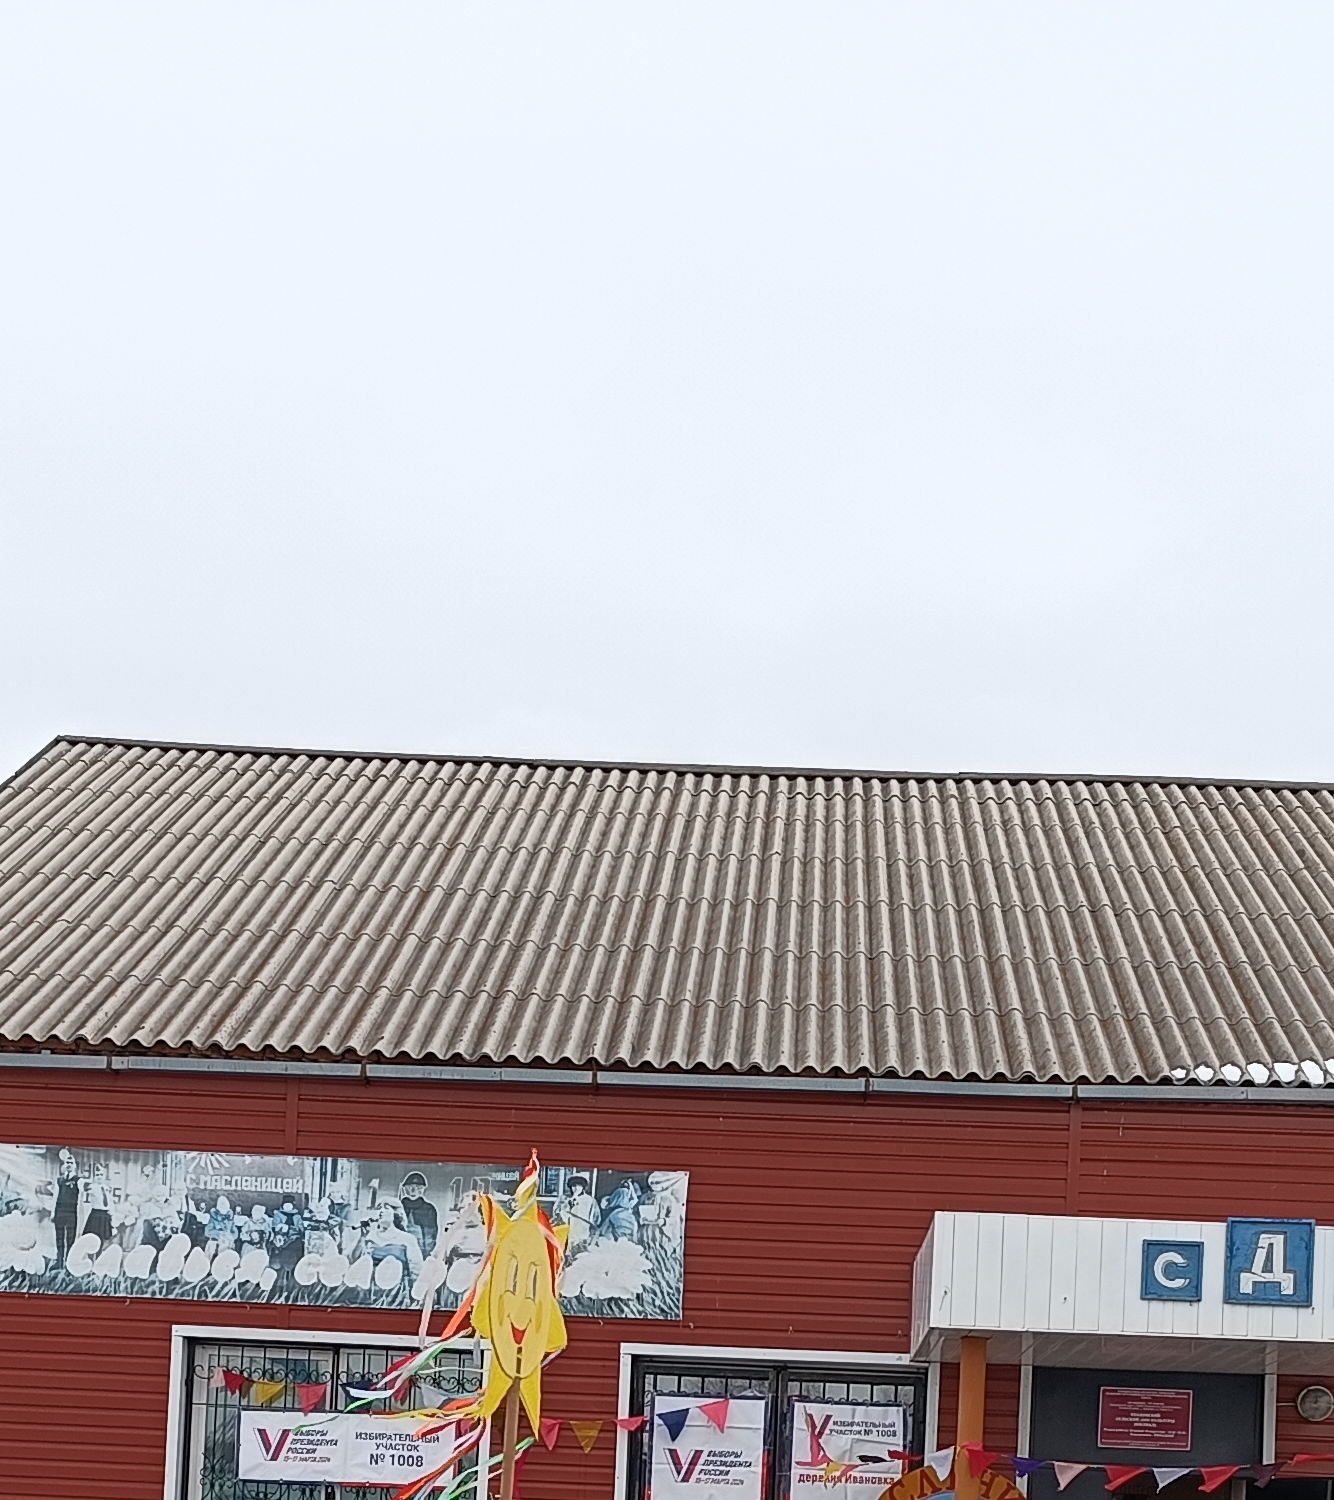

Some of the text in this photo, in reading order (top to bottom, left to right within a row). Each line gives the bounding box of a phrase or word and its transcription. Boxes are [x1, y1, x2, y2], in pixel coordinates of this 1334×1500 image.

[828, 1428, 863, 1437] УЧАСТОК
[876, 1429, 898, 1438] 1008
[374, 1442, 420, 1453] УЧАСТОК
[390, 1454, 424, 1468] 1008
